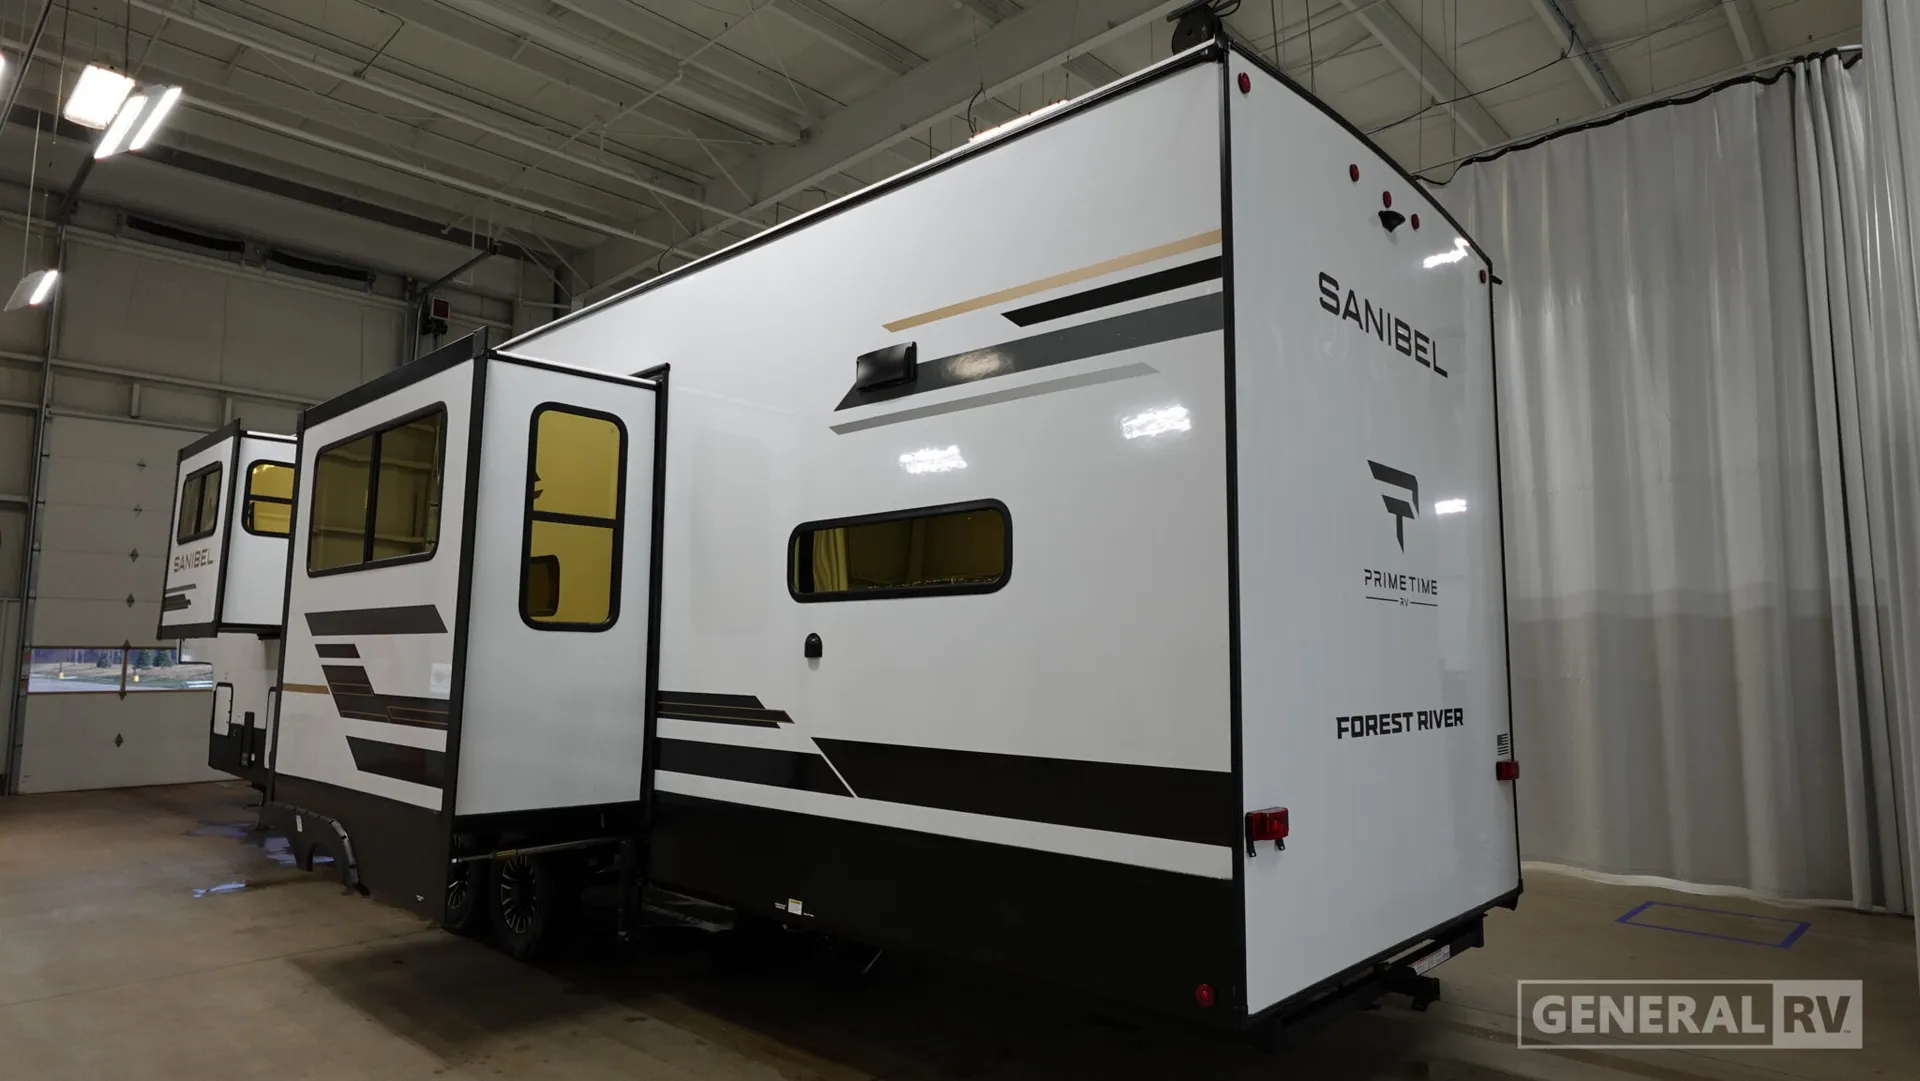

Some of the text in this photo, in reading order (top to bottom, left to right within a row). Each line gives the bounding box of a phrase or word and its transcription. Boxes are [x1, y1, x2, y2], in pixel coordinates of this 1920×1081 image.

[1319, 271, 1448, 378] SANIBEL
[174, 548, 214, 573] SANIBEL
[1336, 707, 1464, 739] FOREST RIVER
